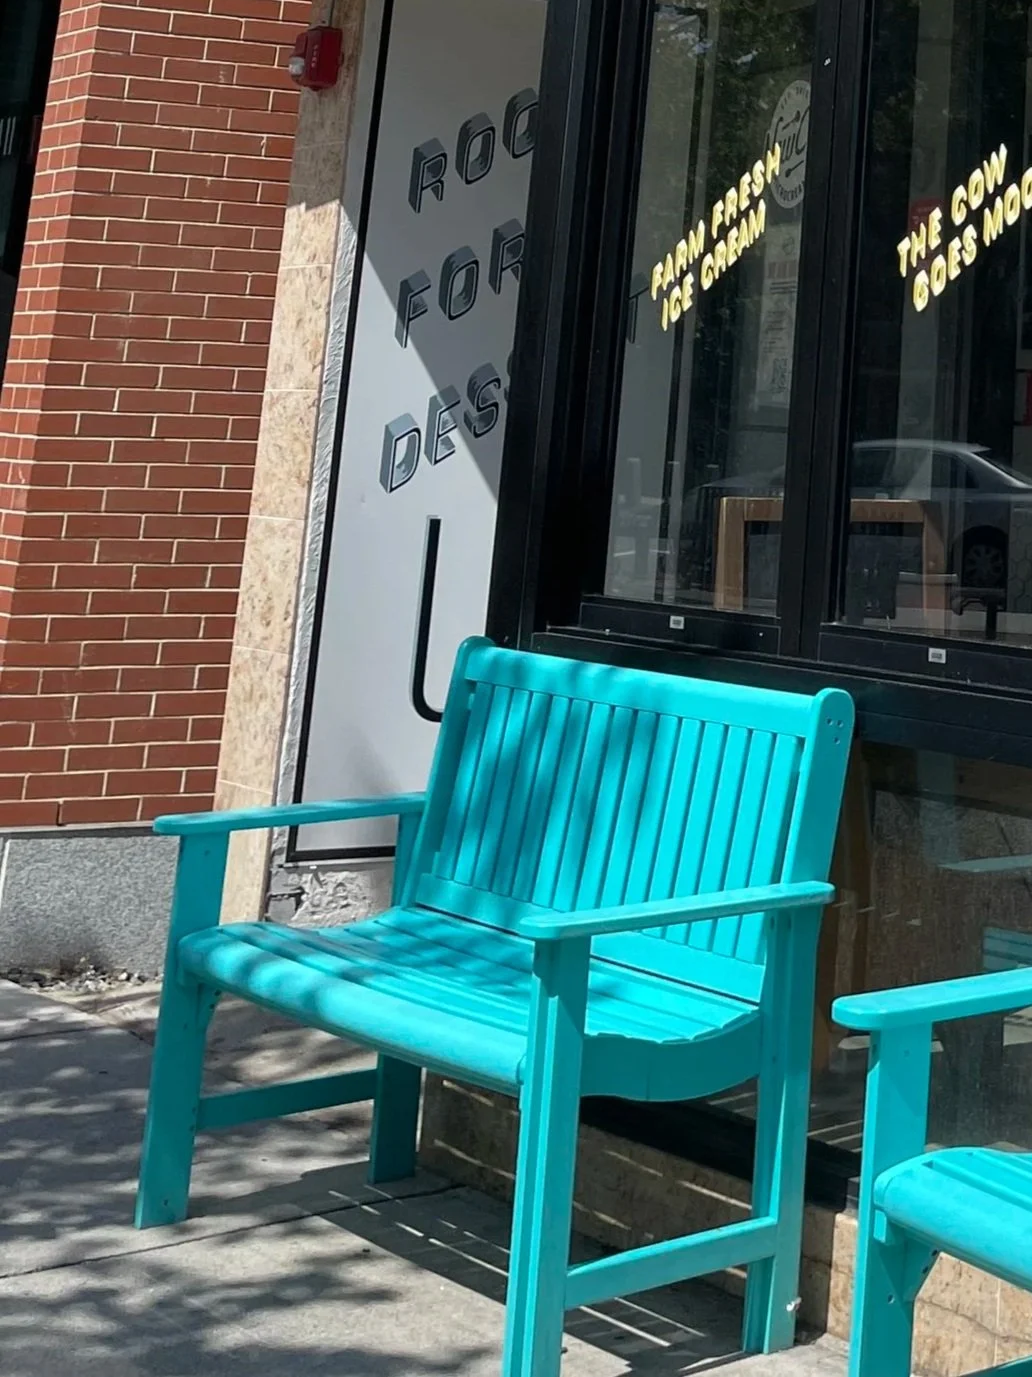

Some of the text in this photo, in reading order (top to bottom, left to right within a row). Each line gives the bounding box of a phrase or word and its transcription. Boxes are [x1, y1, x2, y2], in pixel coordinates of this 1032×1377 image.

[651, 219, 705, 301] FARM
[711, 142, 781, 240] FRESH
[661, 198, 766, 332] ICE CREAM
[897, 142, 1008, 278] THE COW
[913, 224, 977, 313] GOES
[395, 218, 525, 349] FOR
